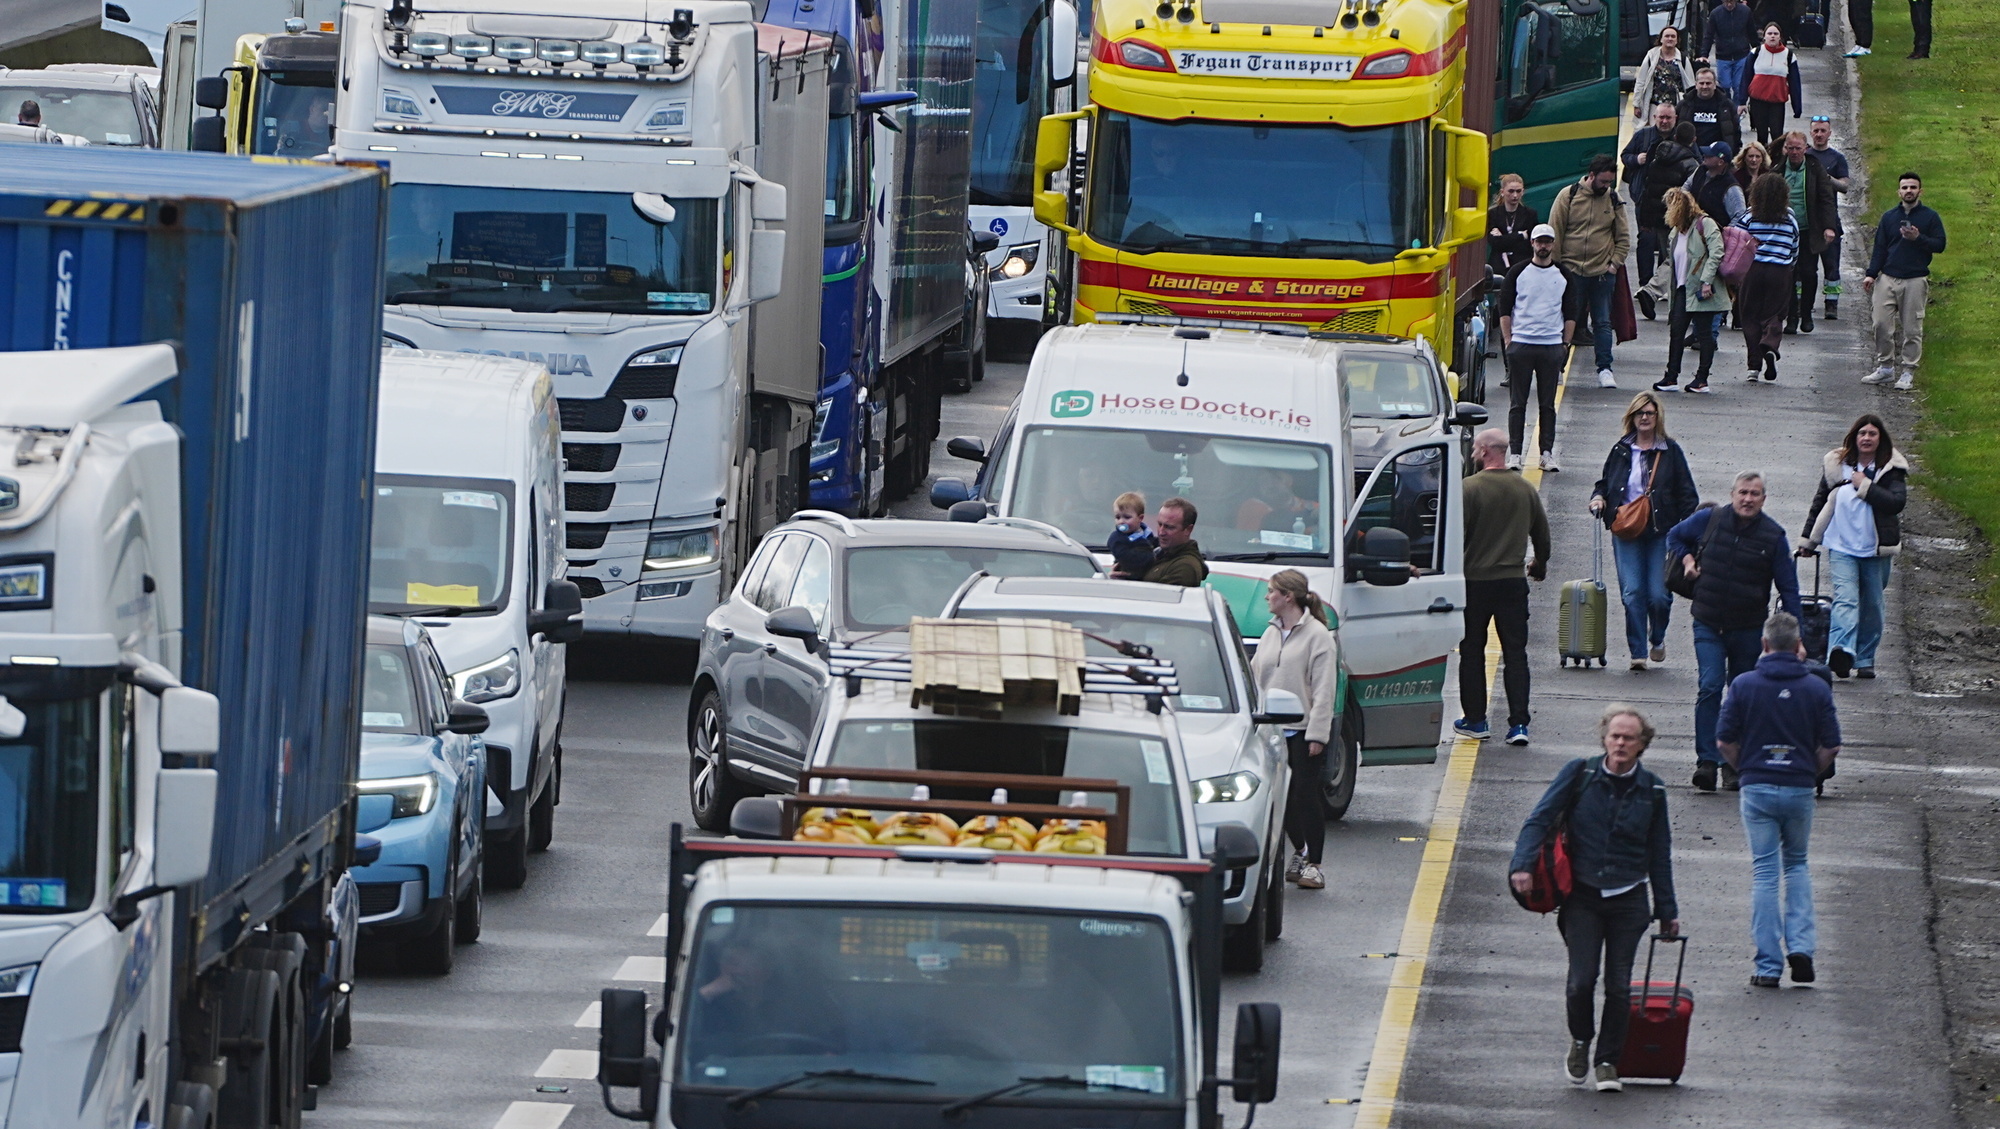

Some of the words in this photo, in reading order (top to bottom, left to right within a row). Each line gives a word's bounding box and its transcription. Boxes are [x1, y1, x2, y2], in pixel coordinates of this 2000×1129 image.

[1178, 52, 1241, 71] Fegan
[1247, 55, 1353, 74] Transport
[568, 112, 607, 120] TRANSPORT
[1149, 274, 1240, 295] Haulage
[1248, 280, 1265, 294] &
[1275, 281, 1366, 299] Storage
[54, 249, 73, 350] CNE
[1207, 308, 1303, 318] www.fegantransport.com
[1100, 408, 1178, 416] PROVIDING
[1186, 411, 1223, 420] HOSE
[1231, 415, 1310, 434] SOLUTIONS
[1364, 684, 1378, 699] 01
[1380, 682, 1401, 698] 419
[1402, 681, 1417, 696] 06
[1419, 680, 1433, 695] 75
